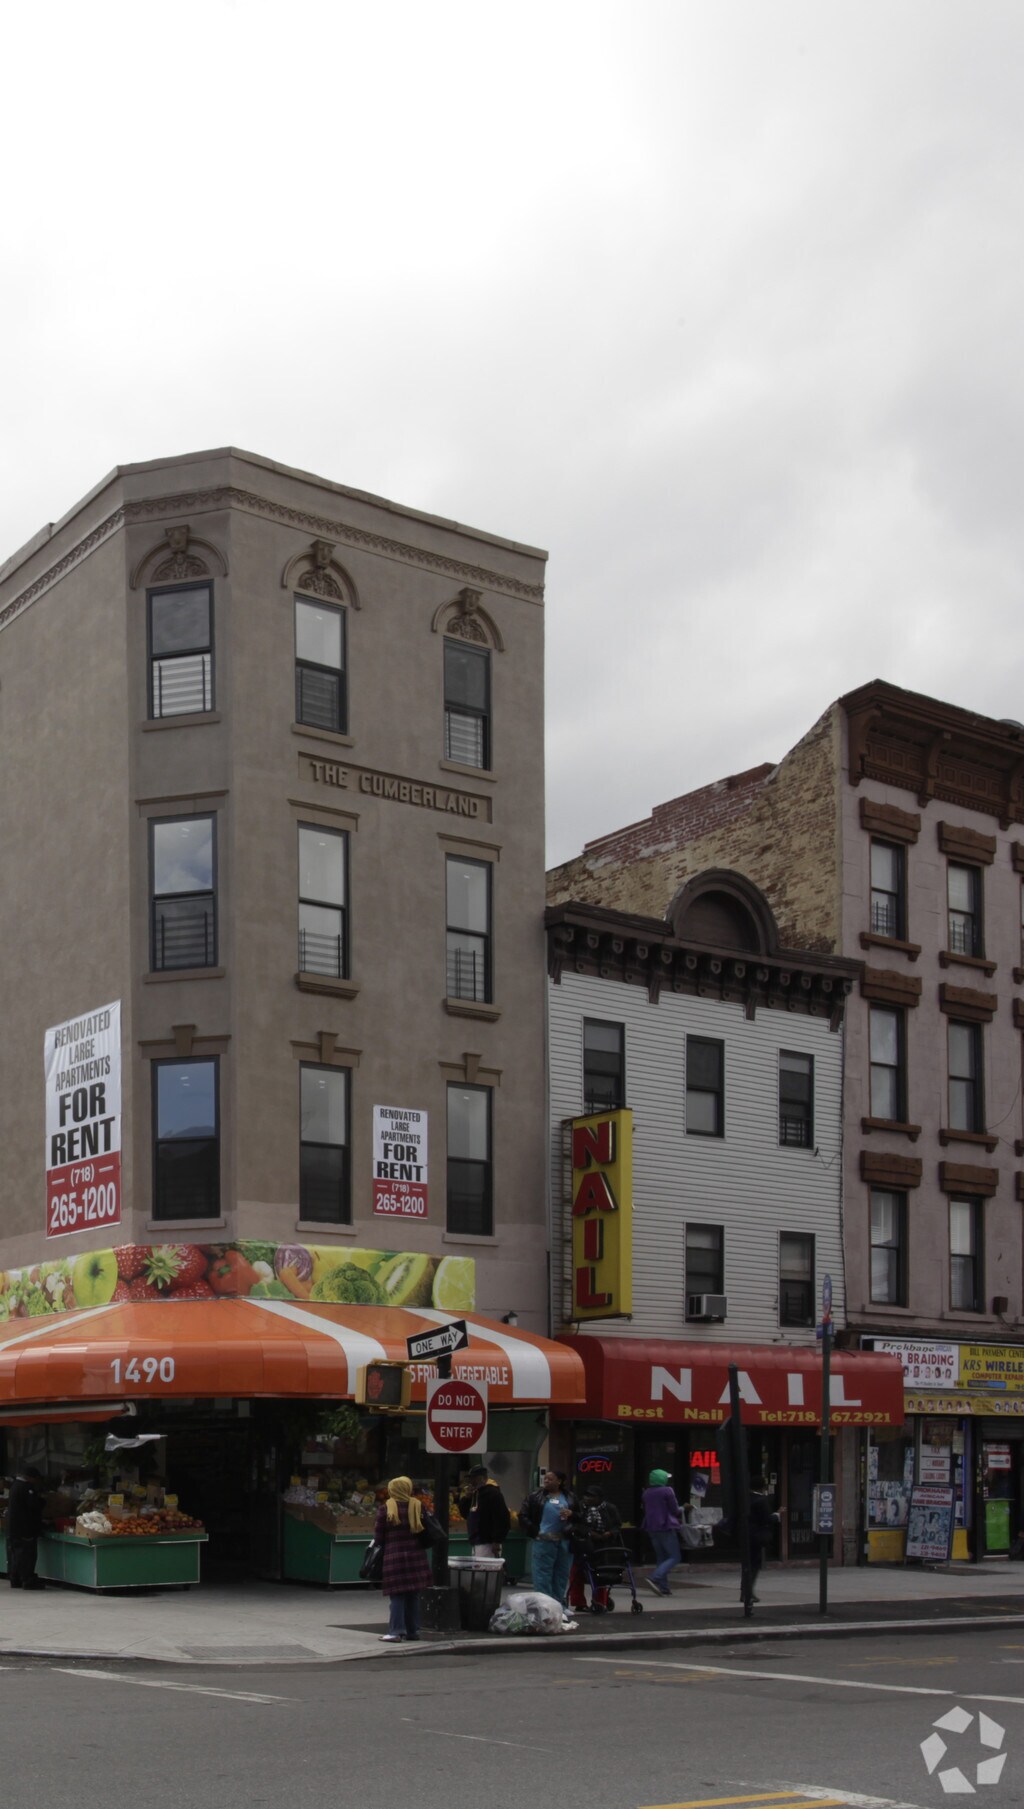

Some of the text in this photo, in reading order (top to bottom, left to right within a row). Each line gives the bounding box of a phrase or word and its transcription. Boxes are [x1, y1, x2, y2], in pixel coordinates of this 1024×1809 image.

[310, 761, 479, 818] THE CUMBERLAND
[54, 1010, 110, 1049] RENOVATED
[69, 1038, 95, 1065] LARGE
[55, 1055, 110, 1092] APARTMENTS
[59, 1081, 106, 1127] FOR
[380, 1108, 421, 1122] RENOVATED
[391, 1121, 410, 1132] LARGE
[51, 1116, 115, 1166] RENT
[380, 1131, 421, 1145] APARTMENTS
[383, 1143, 417, 1163] FOR
[70, 1163, 95, 1187] (718)
[377, 1161, 423, 1182] RENT
[392, 1183, 410, 1194] (718)
[50, 1181, 116, 1228] 265-1200
[376, 1193, 424, 1214] 265-1200
[572, 1120, 618, 1309] NAIL
[416, 1331, 458, 1353] ONE WAY
[970, 1347, 979, 1356] BILL
[982, 1348, 1006, 1357] PAYMENT
[907, 1353, 954, 1366] BRAIDING
[963, 1359, 981, 1371] KRS
[110, 1357, 175, 1384] 1490
[972, 1372, 1002, 1380] COMPUTER
[650, 1365, 862, 1406] NAIL
[438, 1394, 476, 1406] DO NOT
[617, 1404, 664, 1418] Best
[684, 1408, 723, 1420] Nail
[440, 1427, 473, 1438] ENTER
[580, 1460, 614, 1472] OPEN
